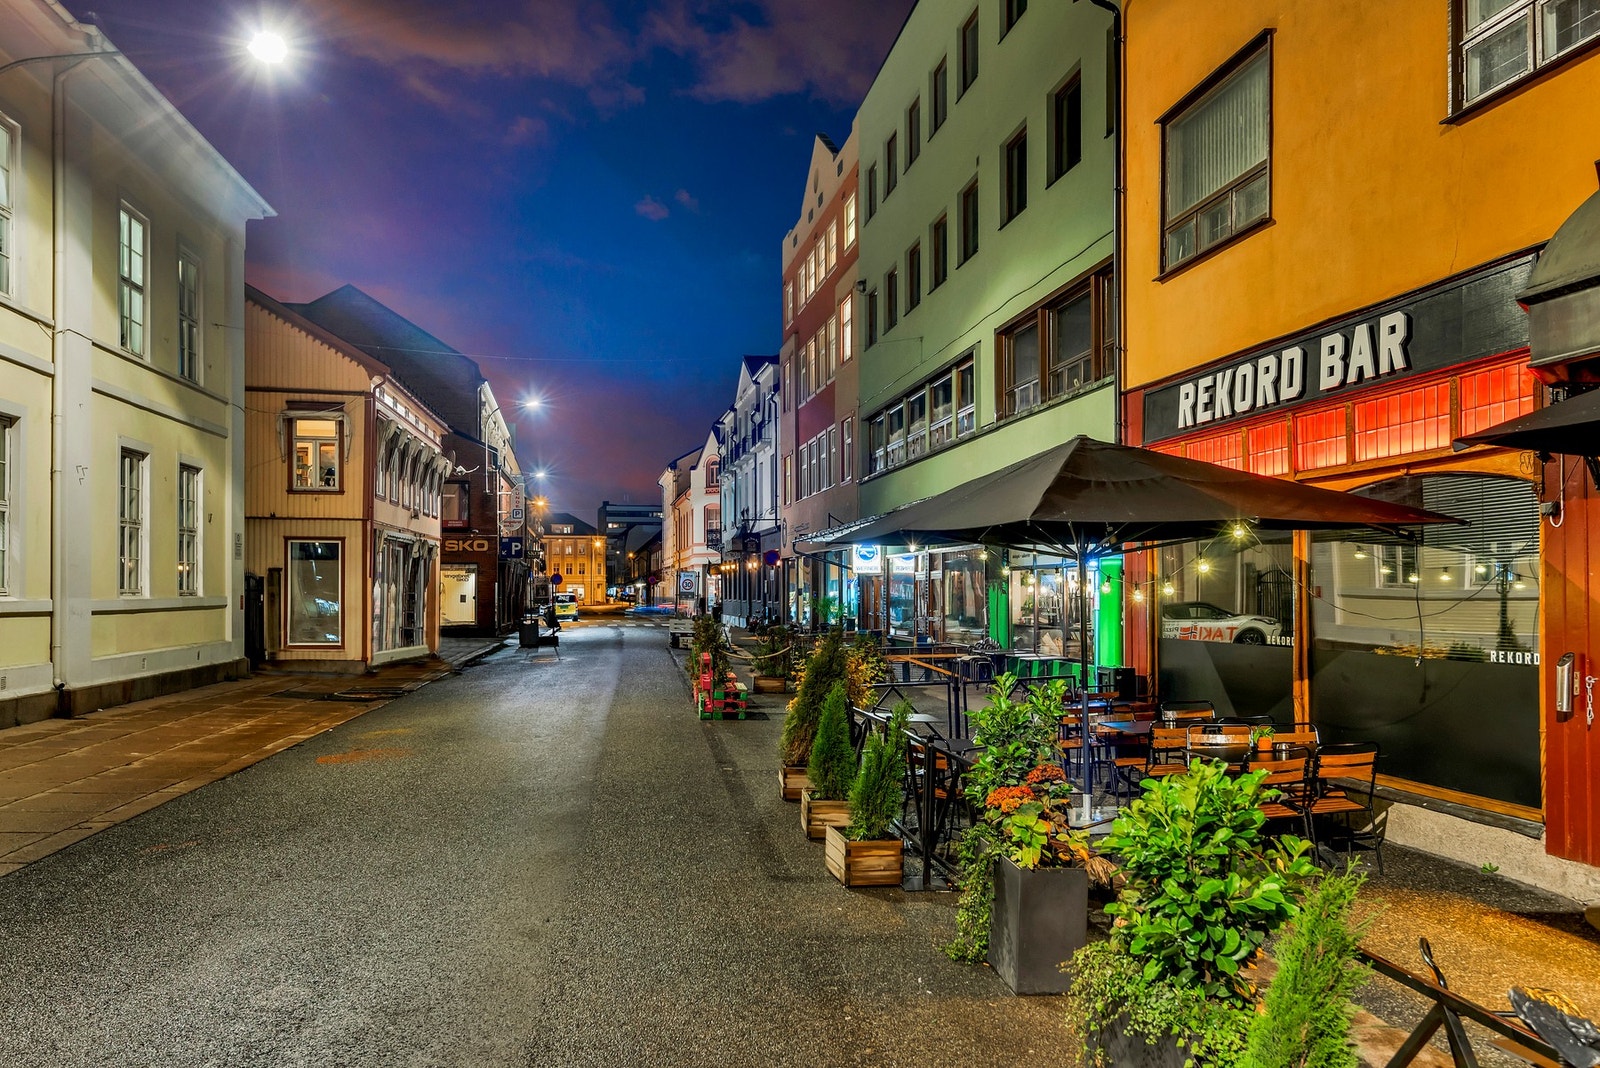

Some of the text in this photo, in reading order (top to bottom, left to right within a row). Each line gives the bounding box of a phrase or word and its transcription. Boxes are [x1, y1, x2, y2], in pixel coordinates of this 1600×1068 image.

[1177, 310, 1412, 429] REKORD BAR
[444, 540, 489, 552] SKO
[511, 542, 521, 555] P
[1490, 650, 1540, 665] REKORD
